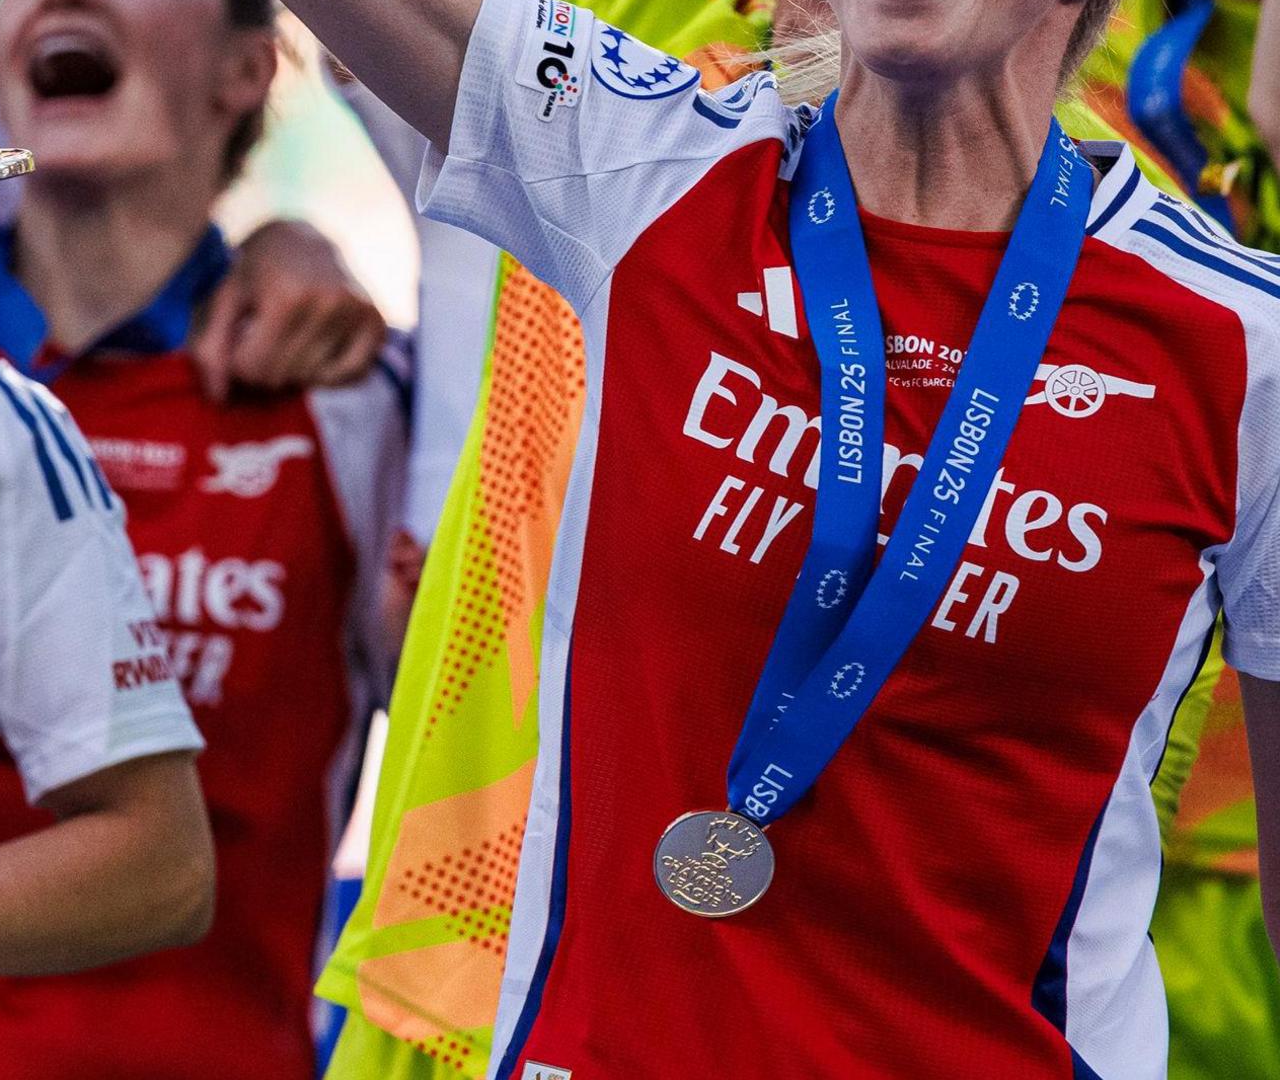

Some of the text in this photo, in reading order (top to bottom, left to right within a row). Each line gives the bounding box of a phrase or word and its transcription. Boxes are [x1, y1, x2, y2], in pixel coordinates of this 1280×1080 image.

[536, 40, 575, 89] 10
[543, 91, 558, 117] YEARS
[1050, 154, 1073, 207] FINAL
[885, 335, 967, 364] SBON 20
[831, 298, 866, 484] LISBON 25 FINAL
[899, 387, 1000, 581] LISBON 25 FINAL
[692, 475, 805, 565] FLY
[744, 763, 793, 819] LISB
